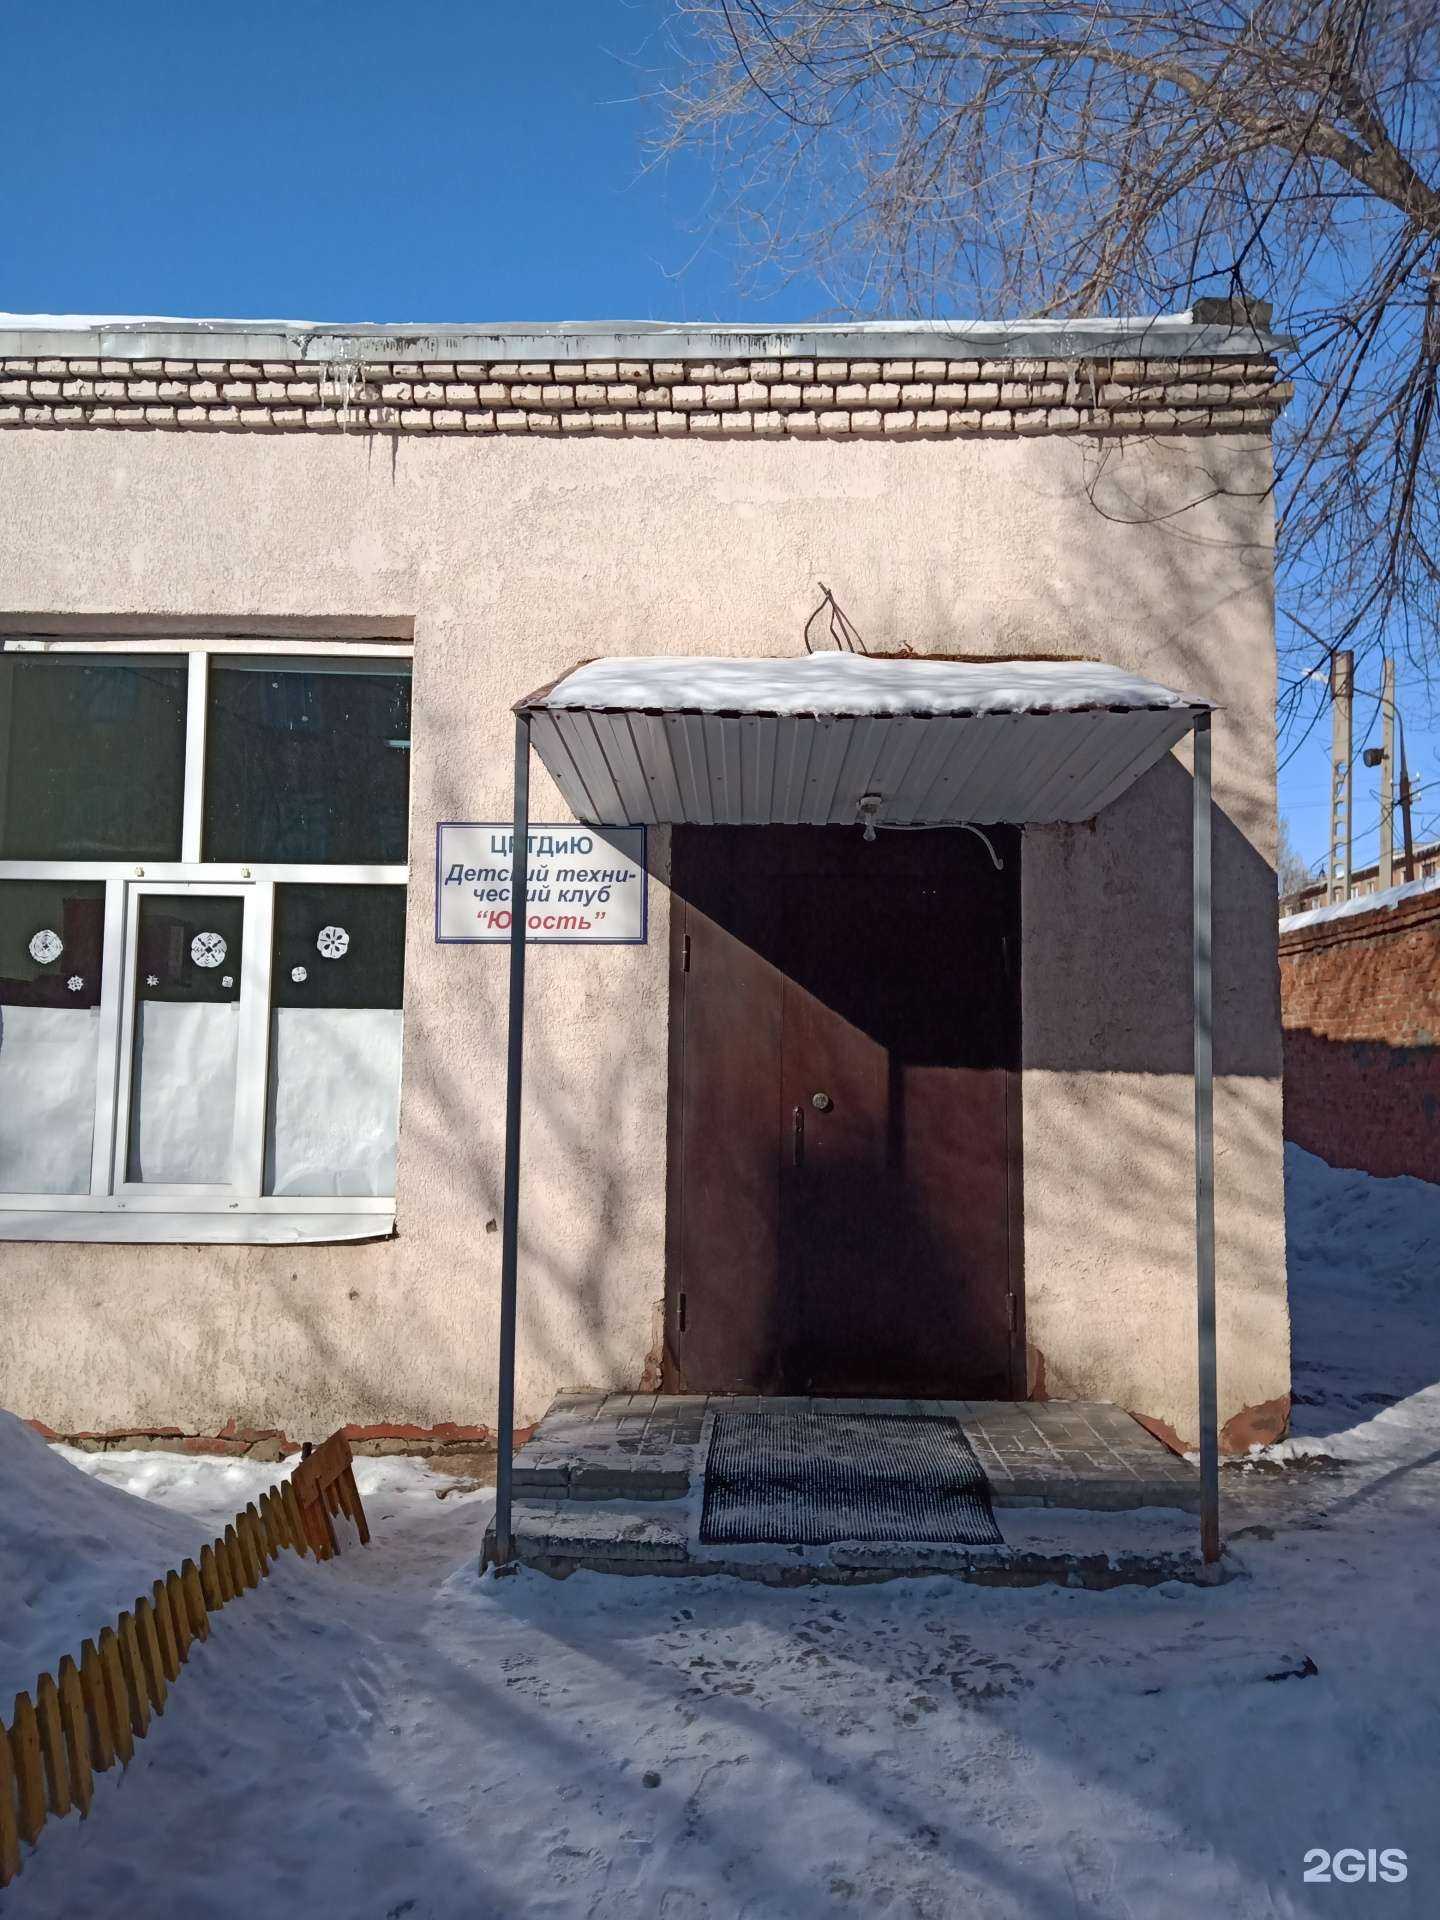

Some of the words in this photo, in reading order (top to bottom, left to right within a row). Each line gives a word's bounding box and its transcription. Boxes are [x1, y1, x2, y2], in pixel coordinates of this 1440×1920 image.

[445, 863, 549, 886] Детсий
[555, 868, 637, 883] техни-
[473, 884, 551, 903] чесий
[557, 884, 612, 907] клуб
[476, 910, 607, 931] “Юость”
